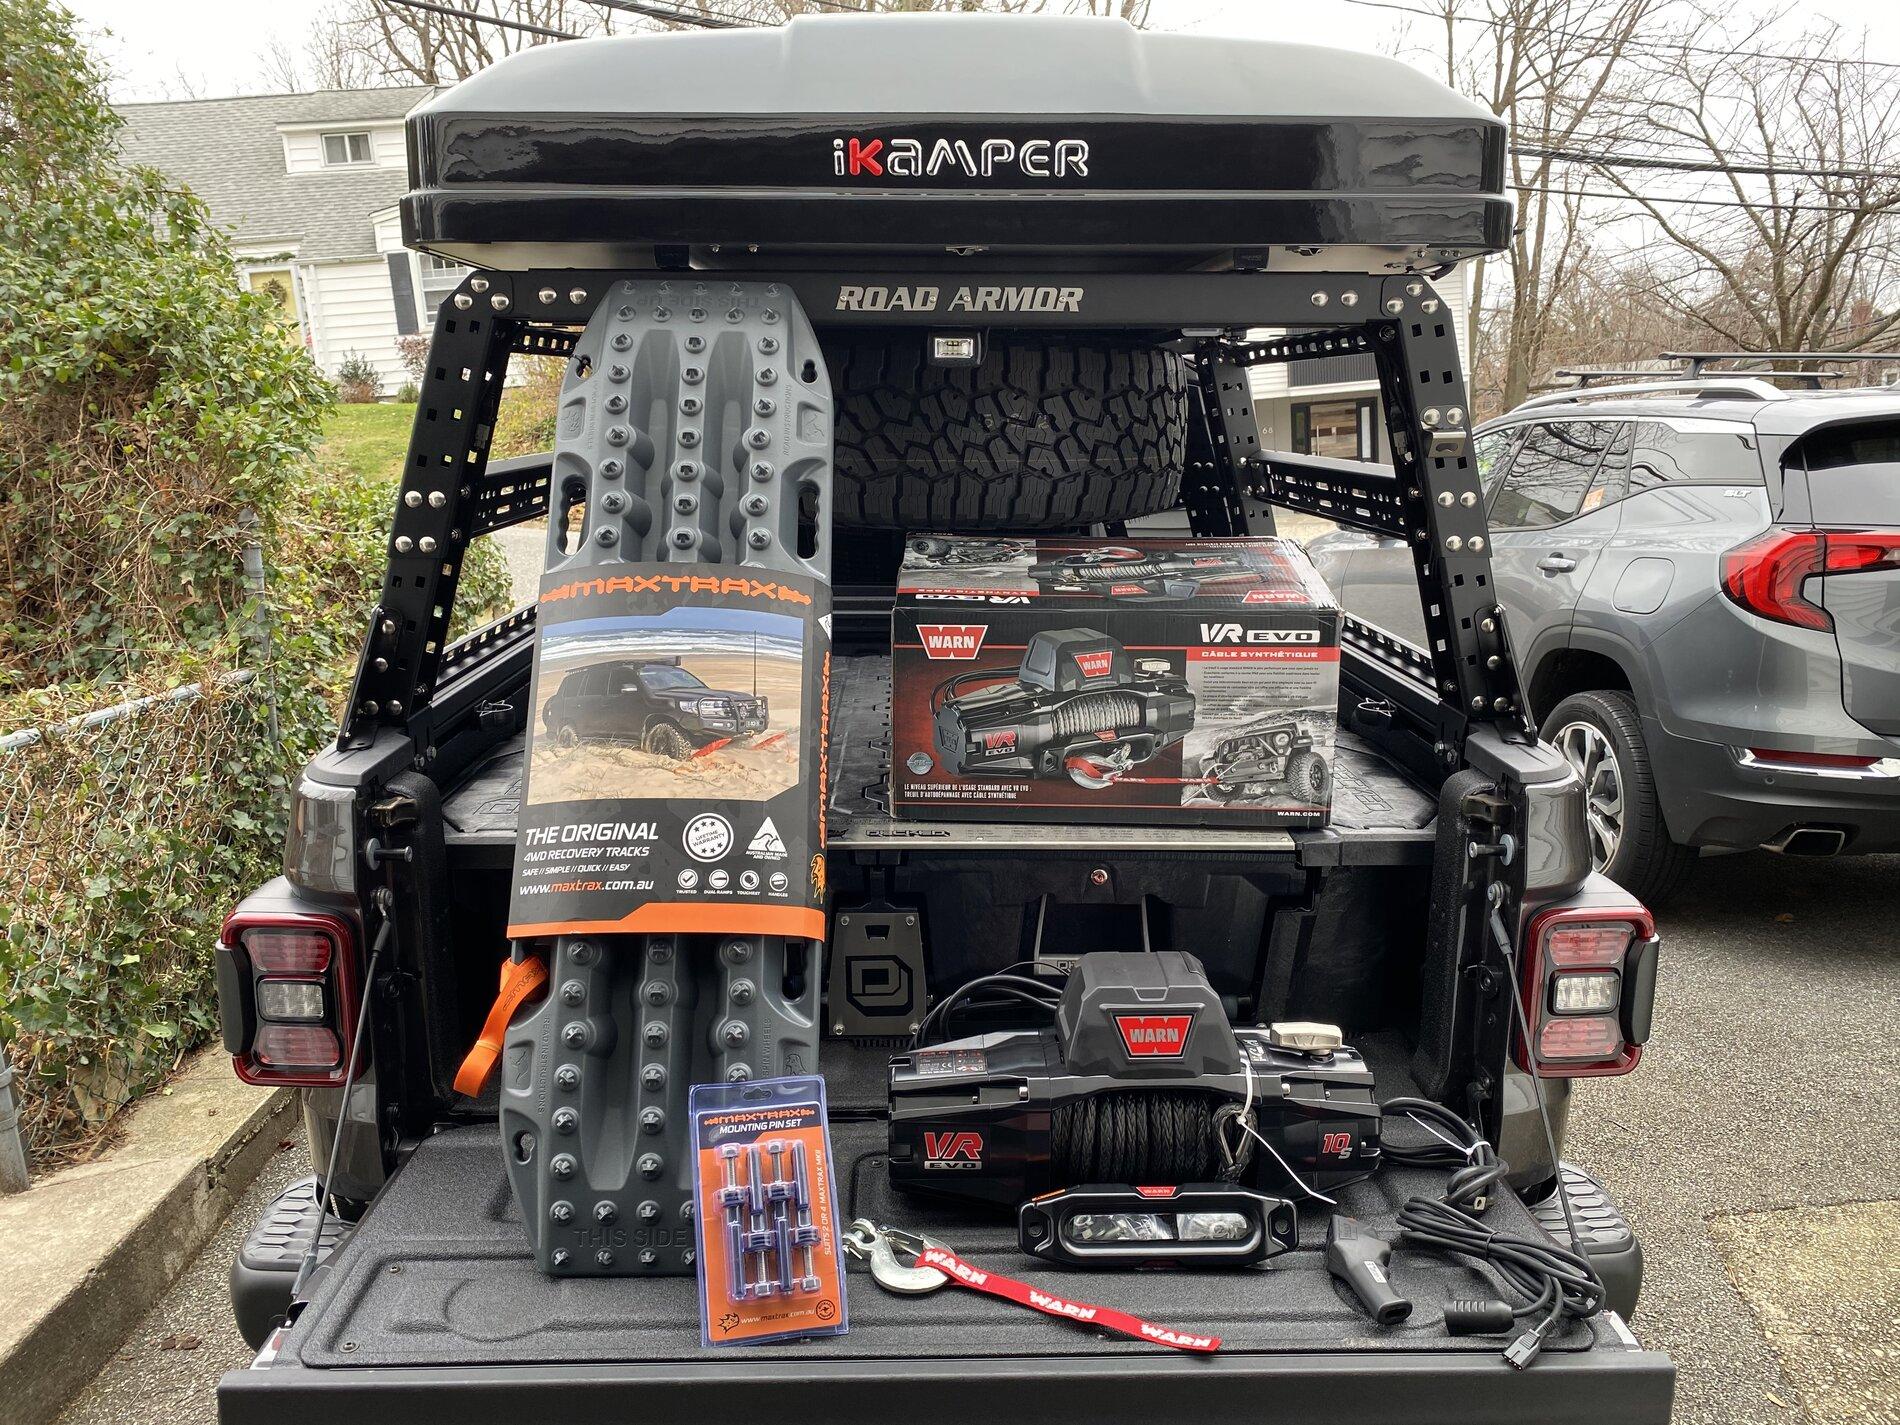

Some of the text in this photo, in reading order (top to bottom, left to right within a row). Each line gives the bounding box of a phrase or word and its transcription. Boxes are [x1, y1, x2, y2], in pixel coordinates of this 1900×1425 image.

[835, 286, 1084, 312] ROAD ARMOR
[1723, 489, 1752, 498] SLT
[568, 574, 777, 599] MAXTRAX
[928, 634, 975, 649] WARN
[1200, 623, 1316, 643] VR EVO
[1201, 650, 1319, 659] CÂBLE SYNTHÉTIQUE
[1082, 659, 1108, 671] WARN
[985, 730, 1016, 748] VR
[525, 822, 659, 846] THE ORIGINAL
[692, 832, 725, 847] WARRANTY
[695, 829, 719, 841] LIFETIME
[523, 846, 650, 863] 4WD RECOVERY TRACKS
[522, 868, 539, 877] SAFE
[544, 866, 570, 875] SIMPLE
[577, 864, 601, 873] QUICK
[609, 863, 631, 872] EASY
[519, 879, 654, 896] www.maxtrax.com.au
[1129, 1026, 1180, 1043] WARN
[538, 1044, 549, 1114] INSTRUCTIONS
[718, 1108, 801, 1124] MAXTRAX
[719, 1118, 803, 1135] MOUNTING PIN SET
[923, 1132, 984, 1160] VR
[573, 1229, 688, 1248] THIS SIDE
[925, 1250, 988, 1286] WARN
[1030, 1291, 1097, 1320] WARN
[740, 1309, 815, 1325] www.maxtrax.com.au
[1140, 1323, 1211, 1348] WARN
